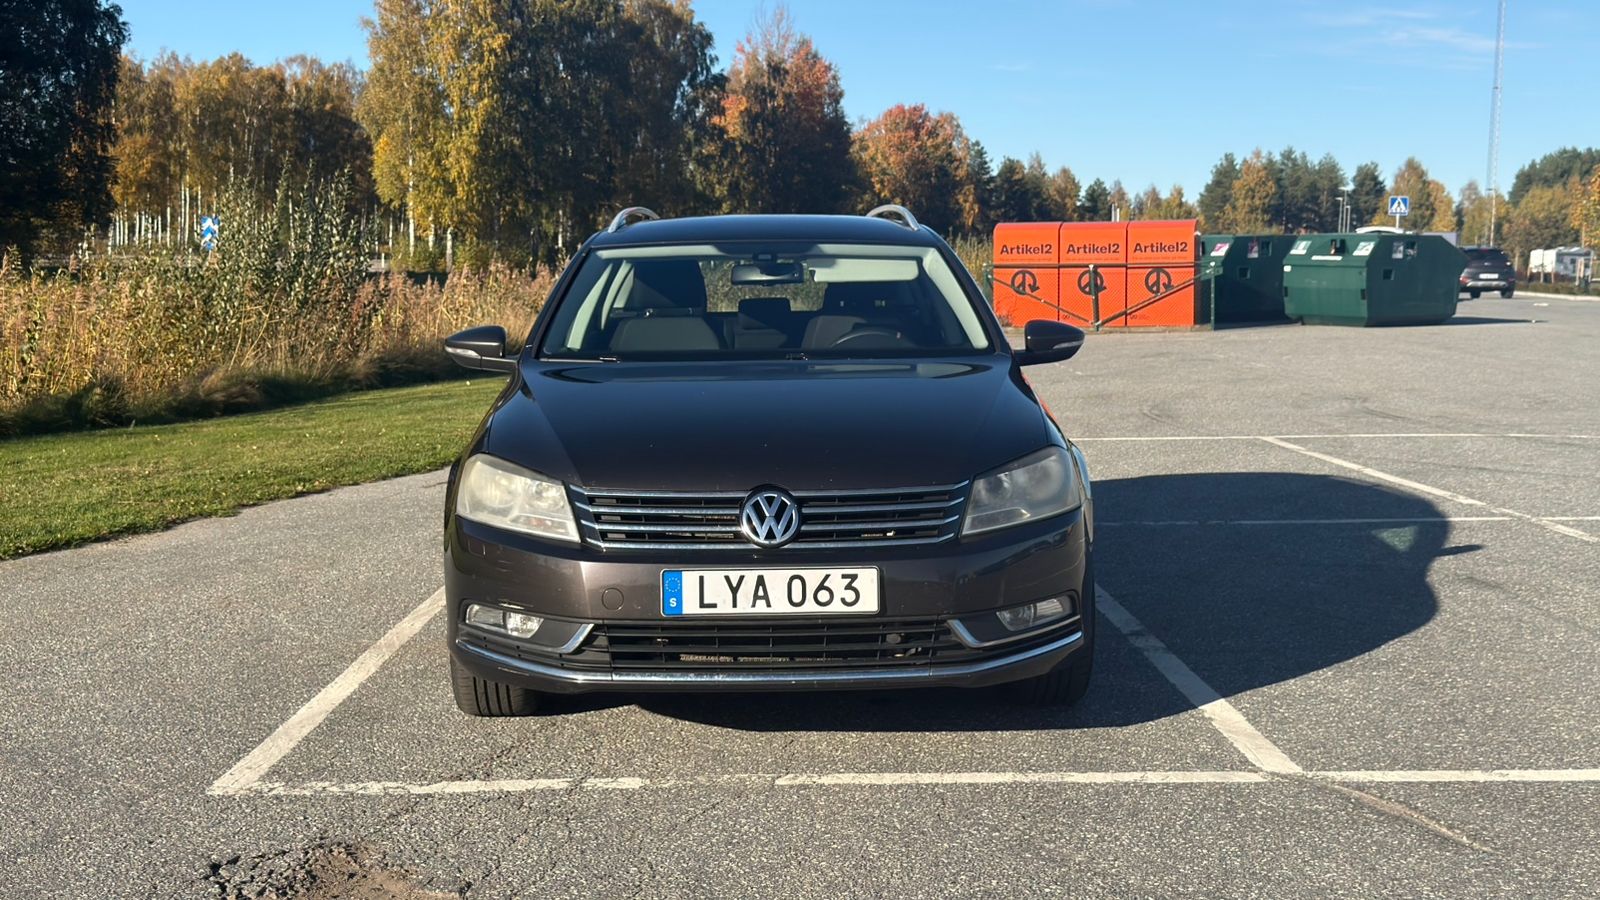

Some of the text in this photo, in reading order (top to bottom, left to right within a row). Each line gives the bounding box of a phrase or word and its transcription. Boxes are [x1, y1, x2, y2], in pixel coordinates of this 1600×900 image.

[1000, 244, 1053, 255] Artikel2
[1066, 243, 1120, 254] Artikel2
[1133, 242, 1188, 253] Artikel2
[744, 492, 798, 543] VW
[698, 573, 861, 609] LYA 063
[669, 598, 677, 608] S
